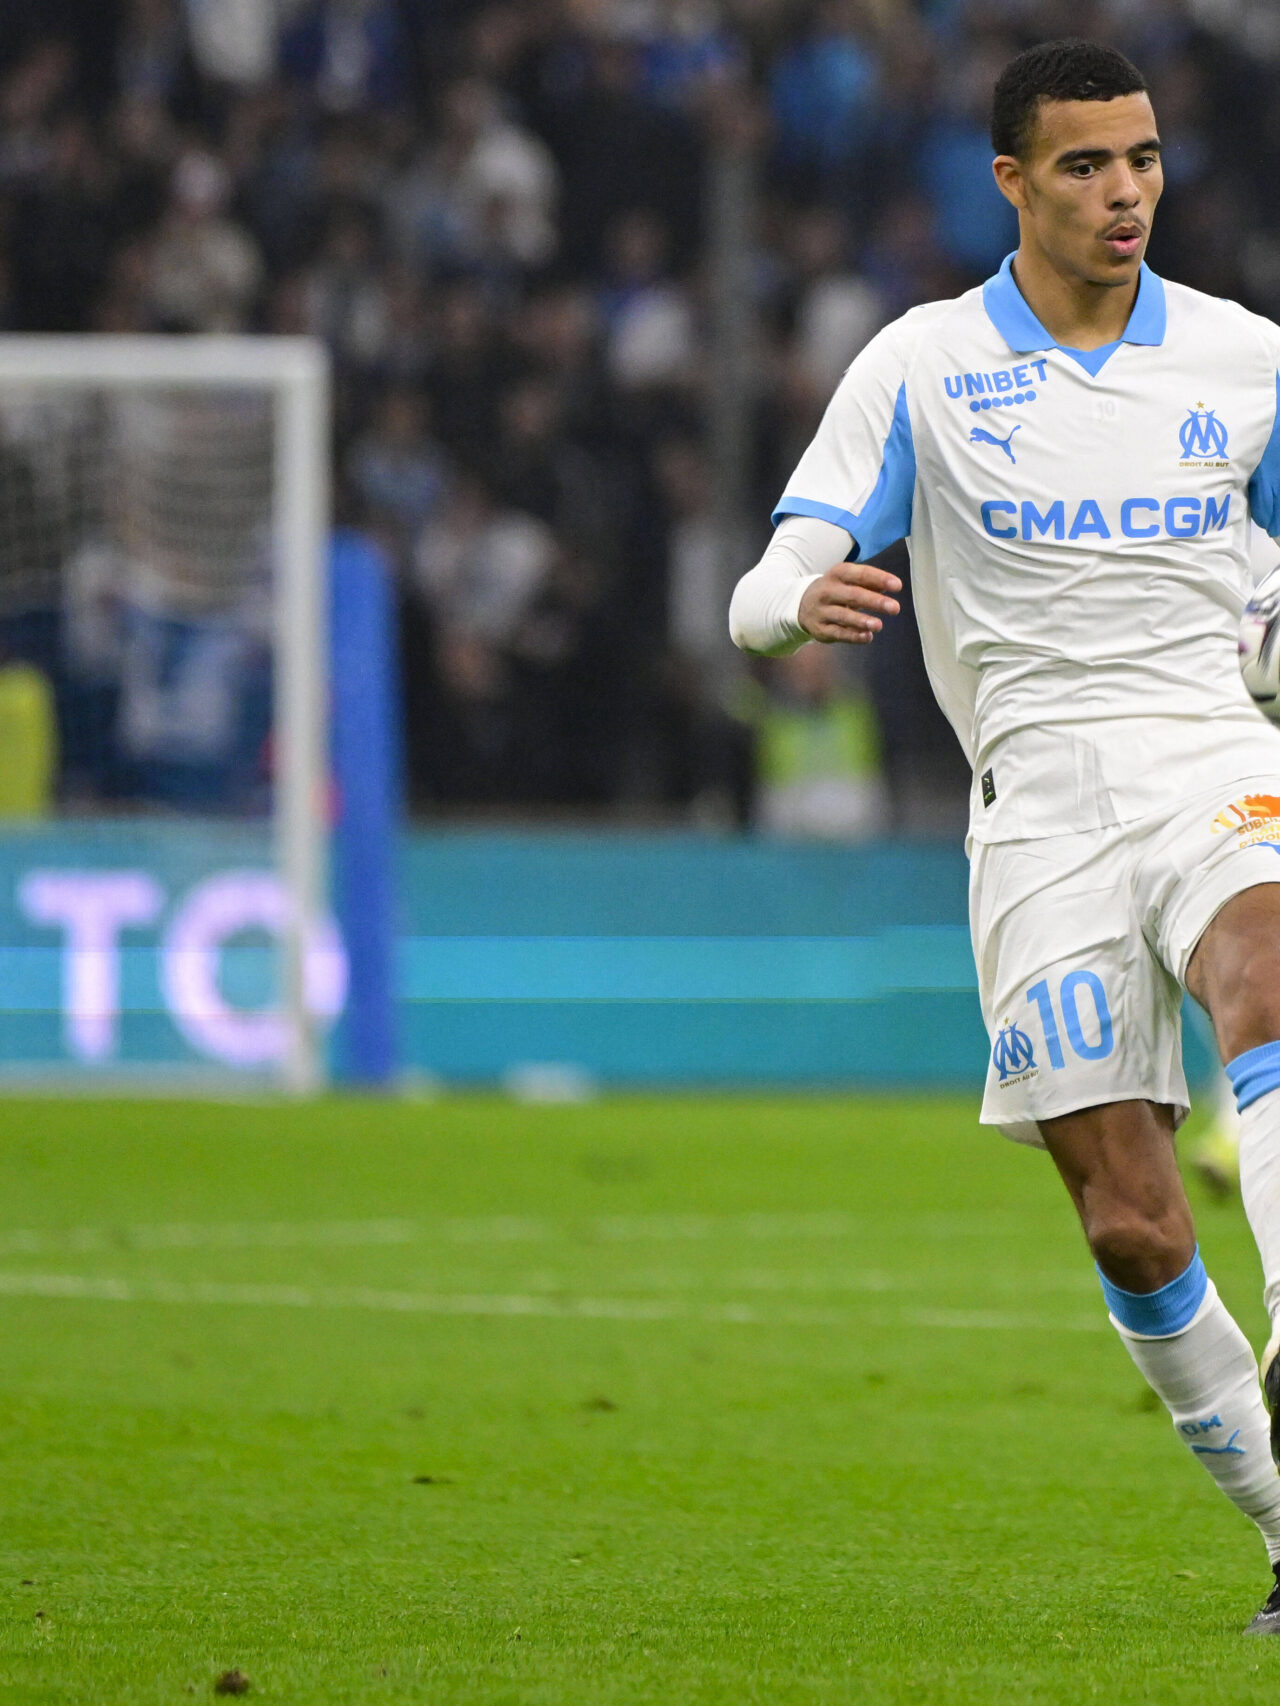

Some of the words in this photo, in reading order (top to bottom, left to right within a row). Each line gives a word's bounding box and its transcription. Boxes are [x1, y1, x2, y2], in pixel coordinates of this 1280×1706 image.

[944, 358, 1048, 399] UNIBET
[980, 499, 1111, 541] CMA
[1120, 493, 1231, 539] CGM
[1026, 970, 1114, 1071] 10
